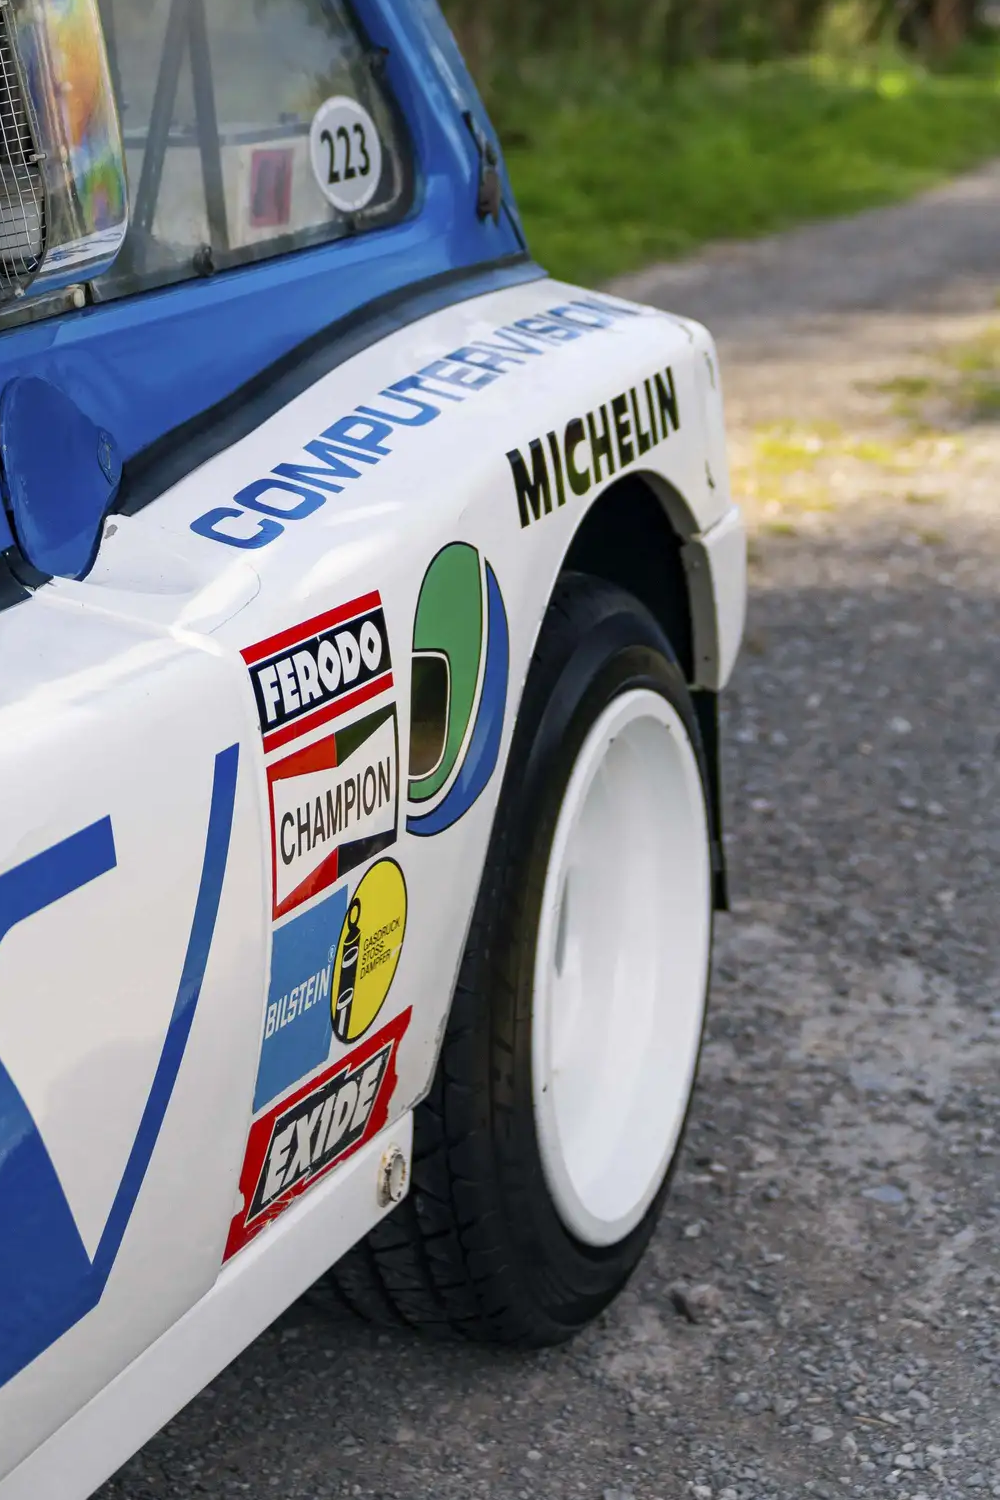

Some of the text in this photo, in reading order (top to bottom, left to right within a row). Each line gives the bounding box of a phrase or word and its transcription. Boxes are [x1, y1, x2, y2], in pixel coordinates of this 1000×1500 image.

[321, 123, 370, 184] 223
[190, 296, 640, 549] COMPUTERVISION
[505, 366, 681, 528] MICHELIN
[258, 620, 382, 723] FERODO
[280, 756, 391, 865] CHAMPION
[363, 915, 401, 951] GASDRUCK
[264, 964, 331, 1040] BILSTEIN
[261, 1054, 384, 1205] EXIDE
